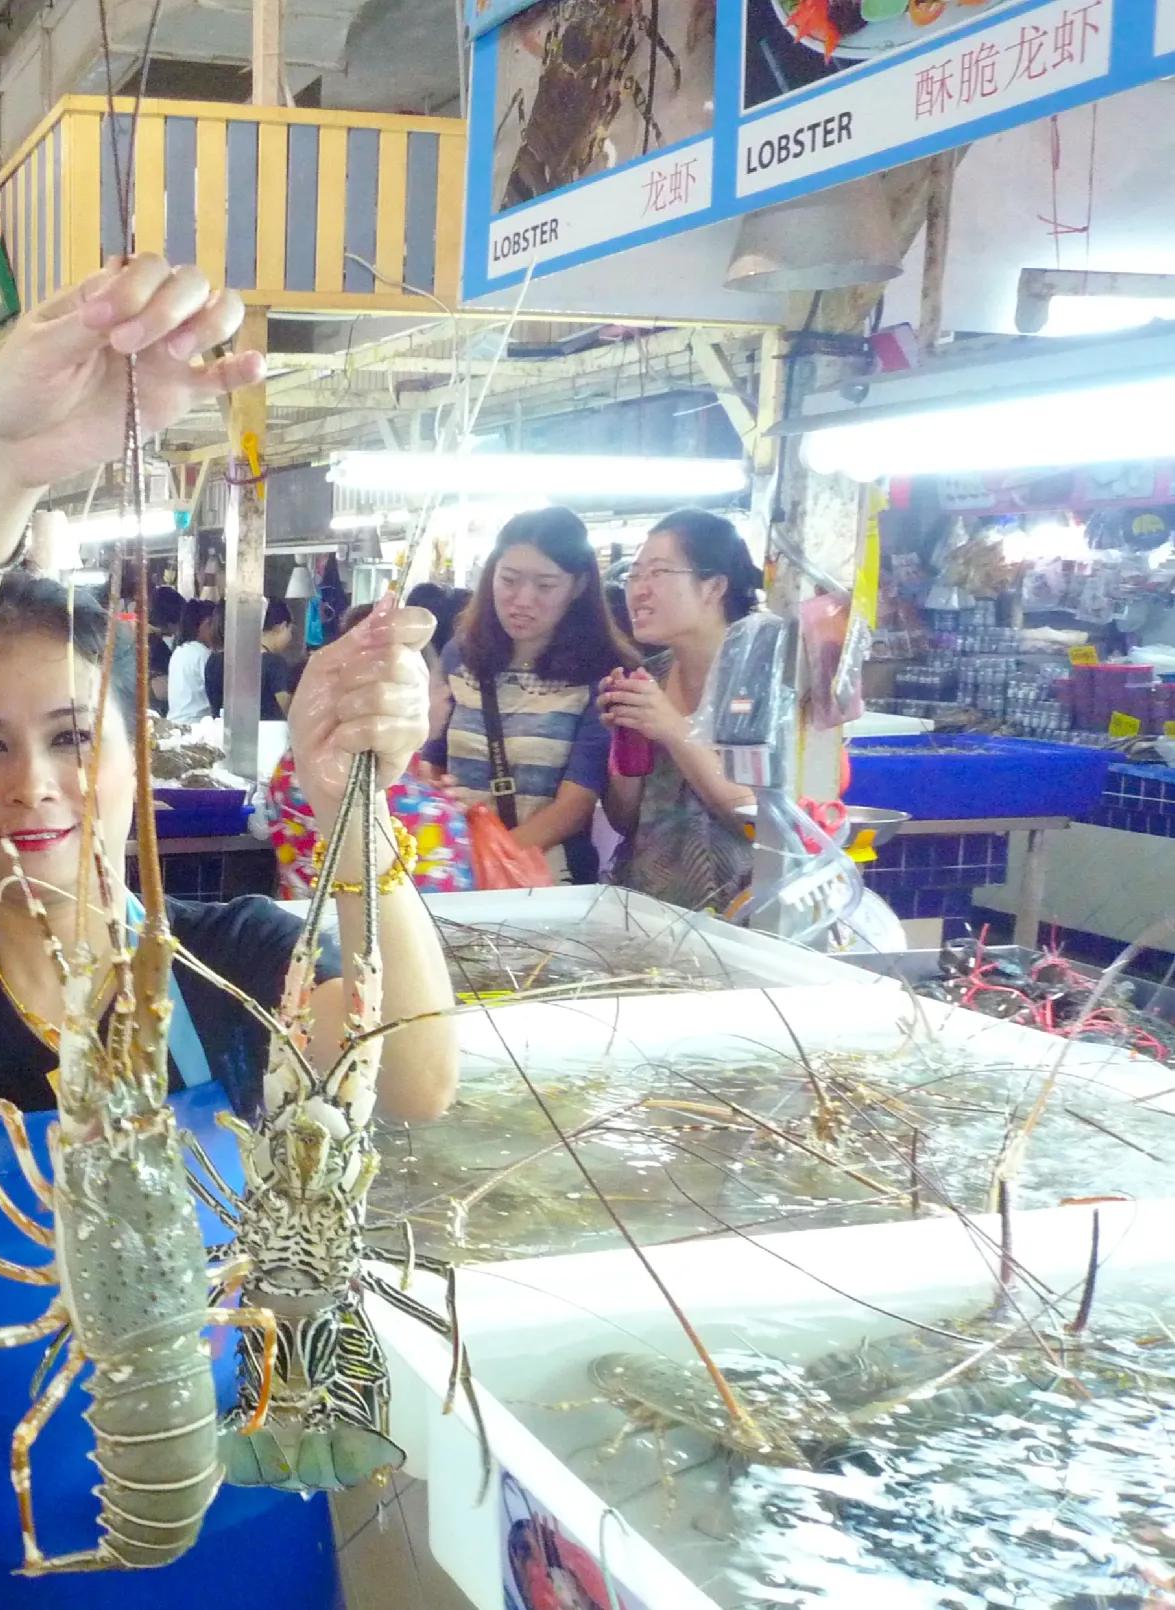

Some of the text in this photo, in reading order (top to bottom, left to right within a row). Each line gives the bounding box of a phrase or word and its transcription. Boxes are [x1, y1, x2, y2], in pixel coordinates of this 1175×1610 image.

[914, 1, 1104, 120] 酥脆龙虾
[746, 111, 853, 175] LOBSTER
[642, 158, 698, 217] 龙虾
[493, 218, 559, 262] LOBSTER
